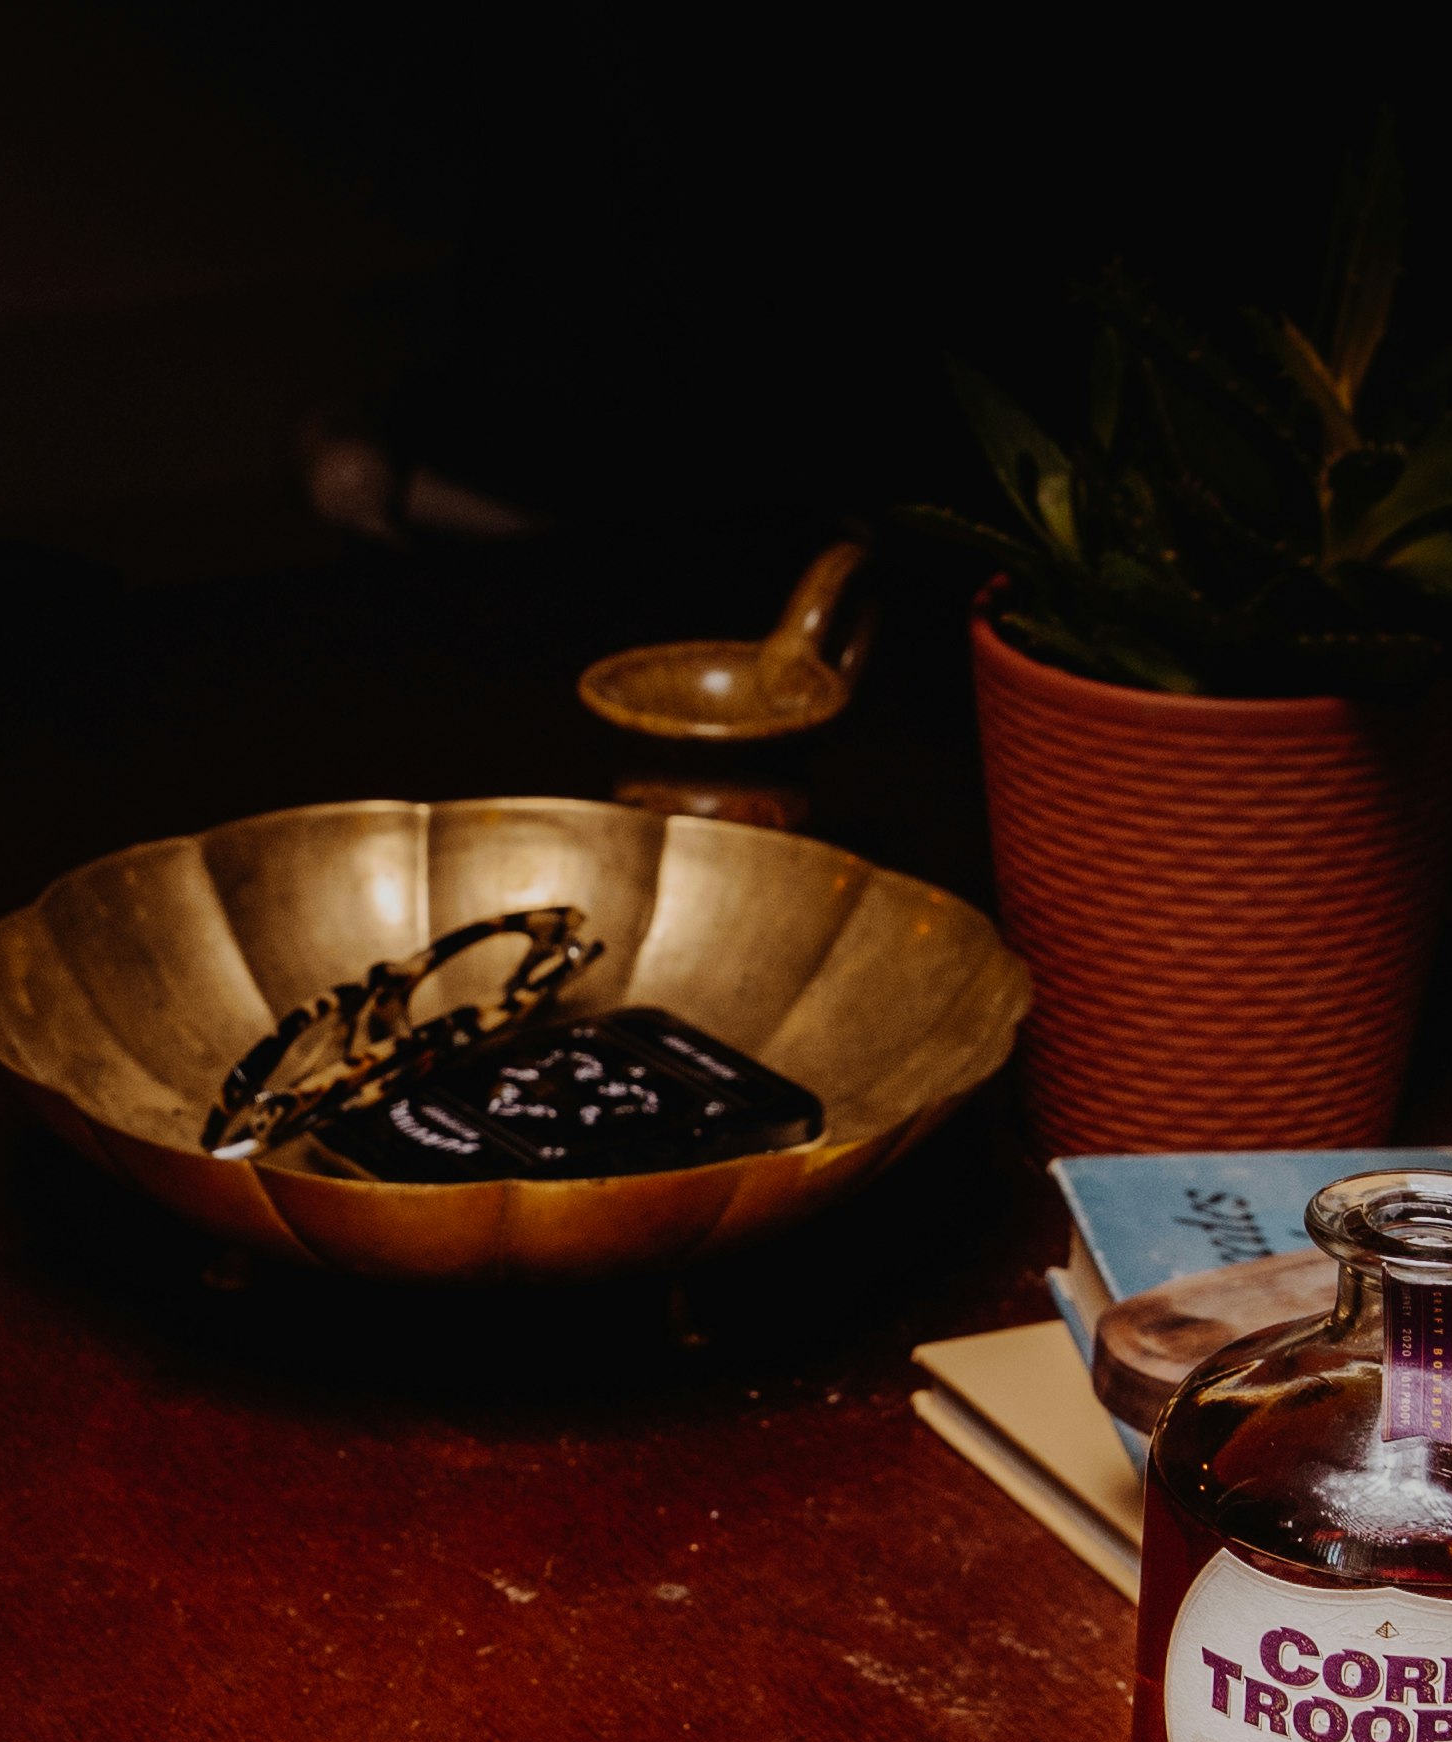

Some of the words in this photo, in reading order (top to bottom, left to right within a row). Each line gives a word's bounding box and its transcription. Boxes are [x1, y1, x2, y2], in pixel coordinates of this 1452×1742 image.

[1401, 1328, 1413, 1357] 2020
[1431, 1347, 1444, 1430] BOURBON
[1399, 1390, 1412, 1426] PROOF
